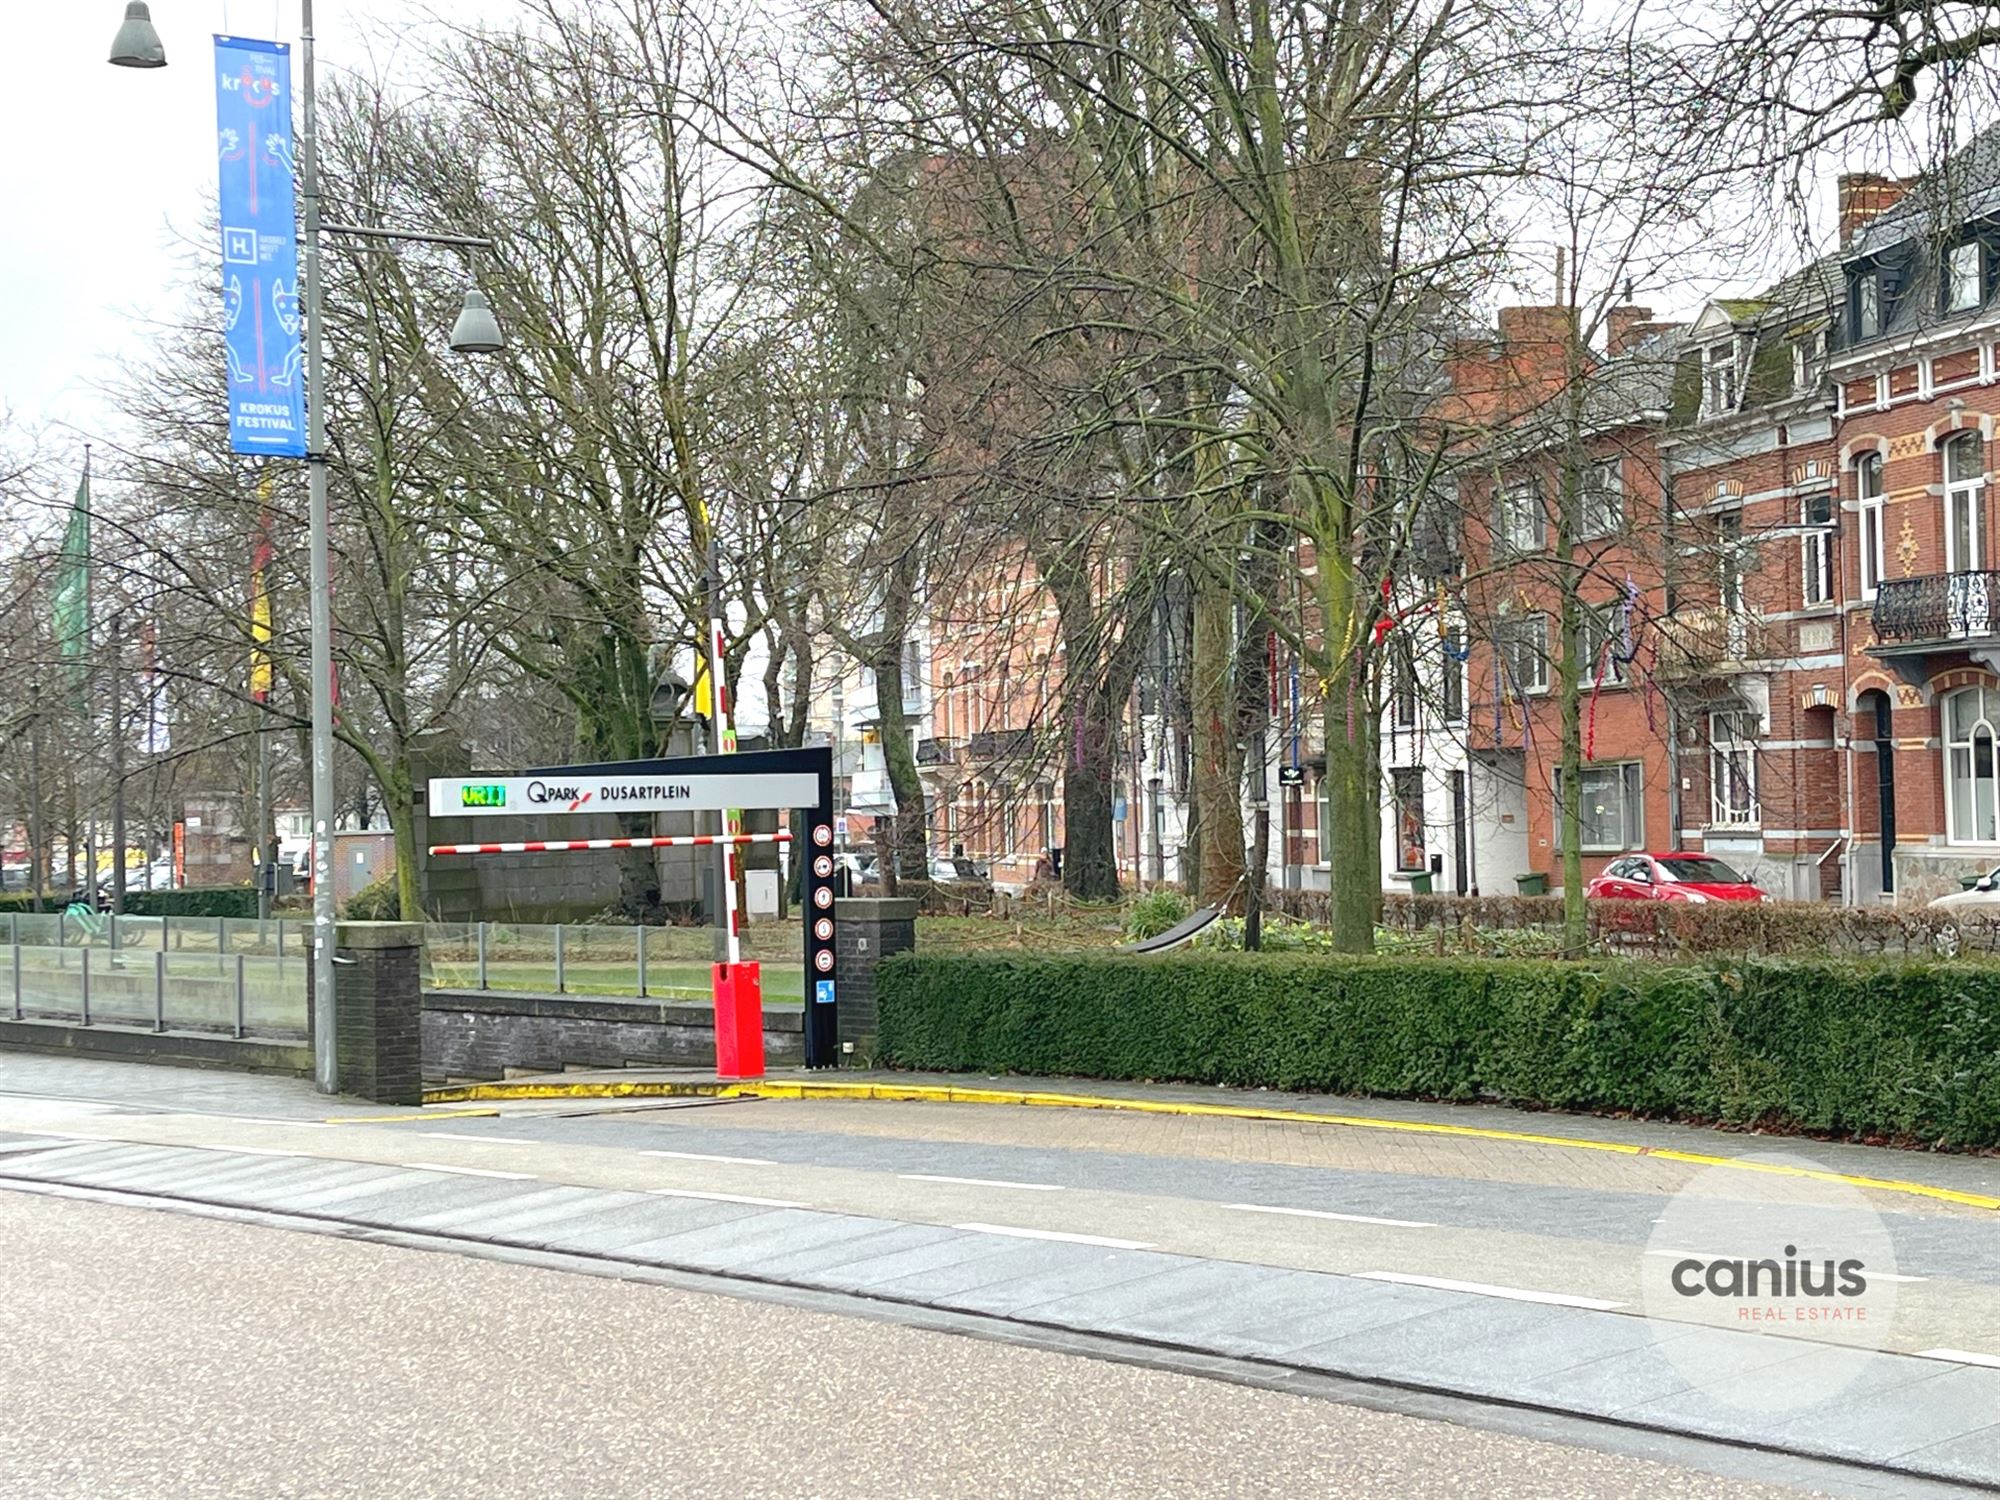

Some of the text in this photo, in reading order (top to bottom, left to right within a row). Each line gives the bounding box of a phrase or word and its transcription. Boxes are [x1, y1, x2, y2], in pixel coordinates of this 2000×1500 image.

[240, 402, 290, 417] KROKUS
[236, 416, 297, 431] FESTIVAL
[601, 785, 690, 800] DUSARTPLEIN
